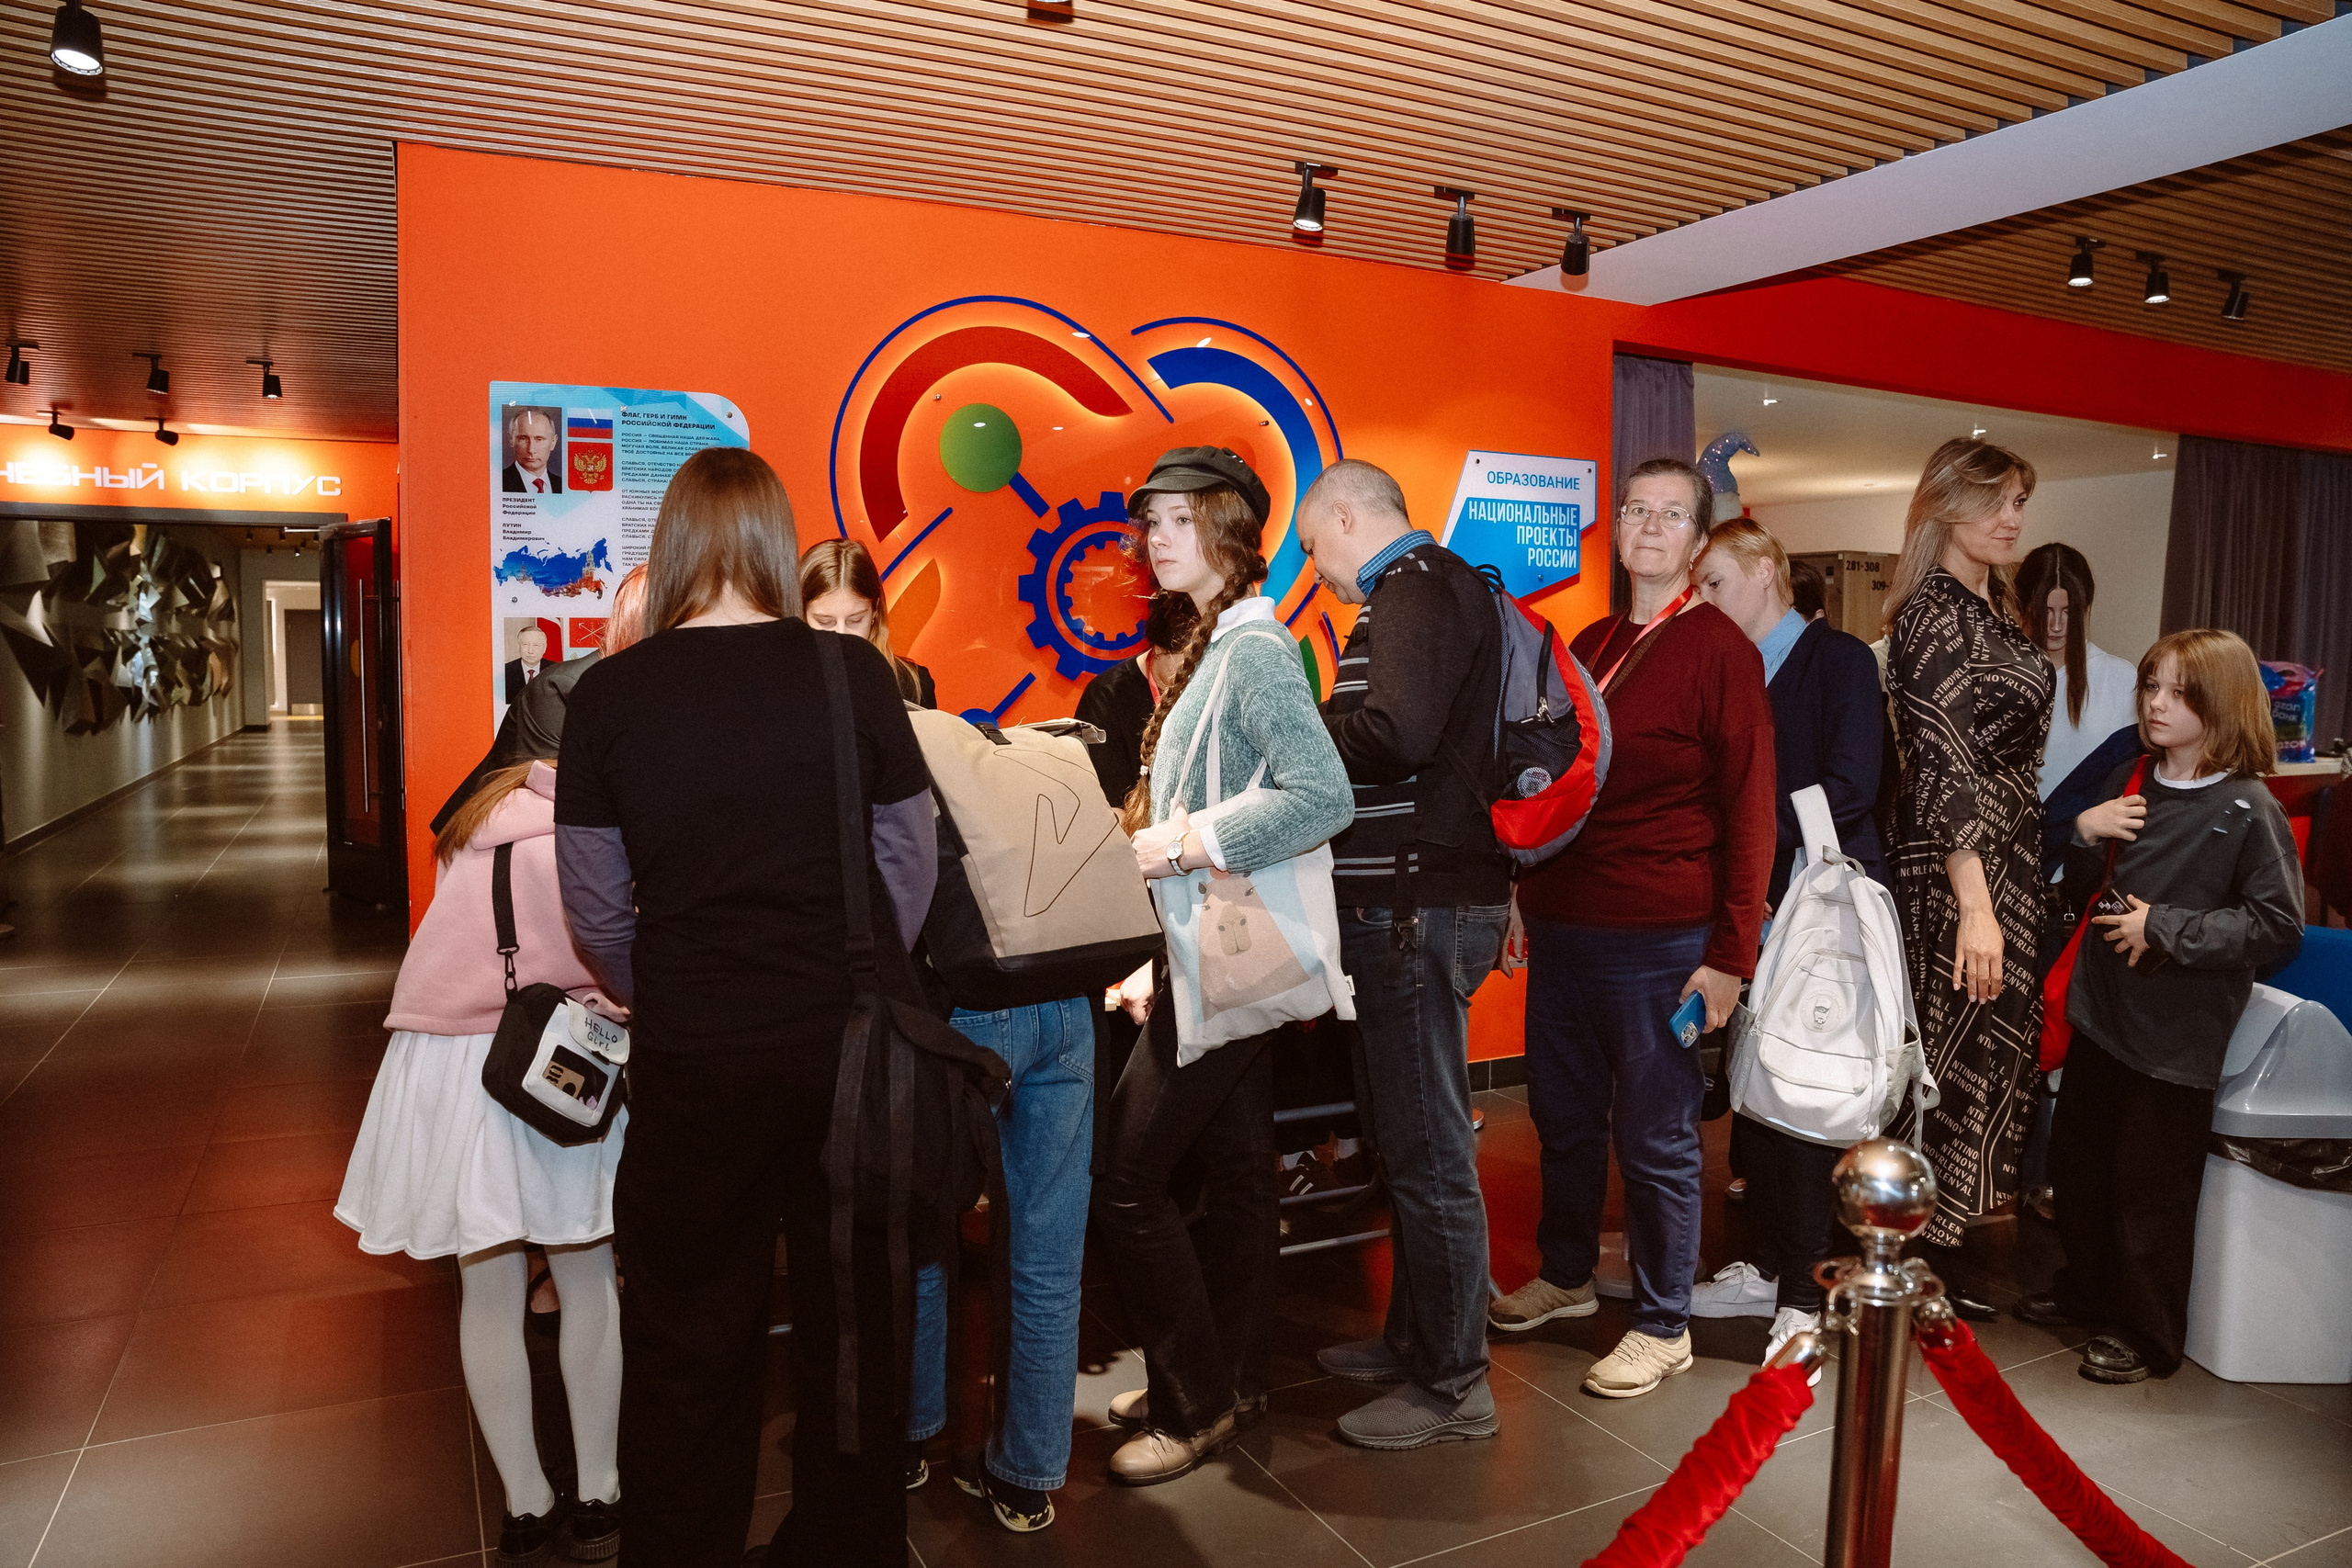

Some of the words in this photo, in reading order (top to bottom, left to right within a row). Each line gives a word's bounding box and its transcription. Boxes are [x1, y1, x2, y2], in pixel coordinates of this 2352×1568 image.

[621, 420, 672, 428] РОССИЙСКОЙ
[673, 422, 716, 430] ФЕДЕРАЦИИ
[181, 469, 342, 497] КОРПУС
[1487, 470, 1580, 491] ОБРАЗОВАНИЕ
[1468, 501, 1577, 526] НАЦИОНАЛЬНЫЕ
[1516, 525, 1577, 547] ПРОЕКТЫ
[1527, 547, 1577, 569] РОССИИ
[1845, 559, 1881, 573] 281-308
[583, 1017, 618, 1043] HELLO
[586, 1031, 611, 1052] Girl
